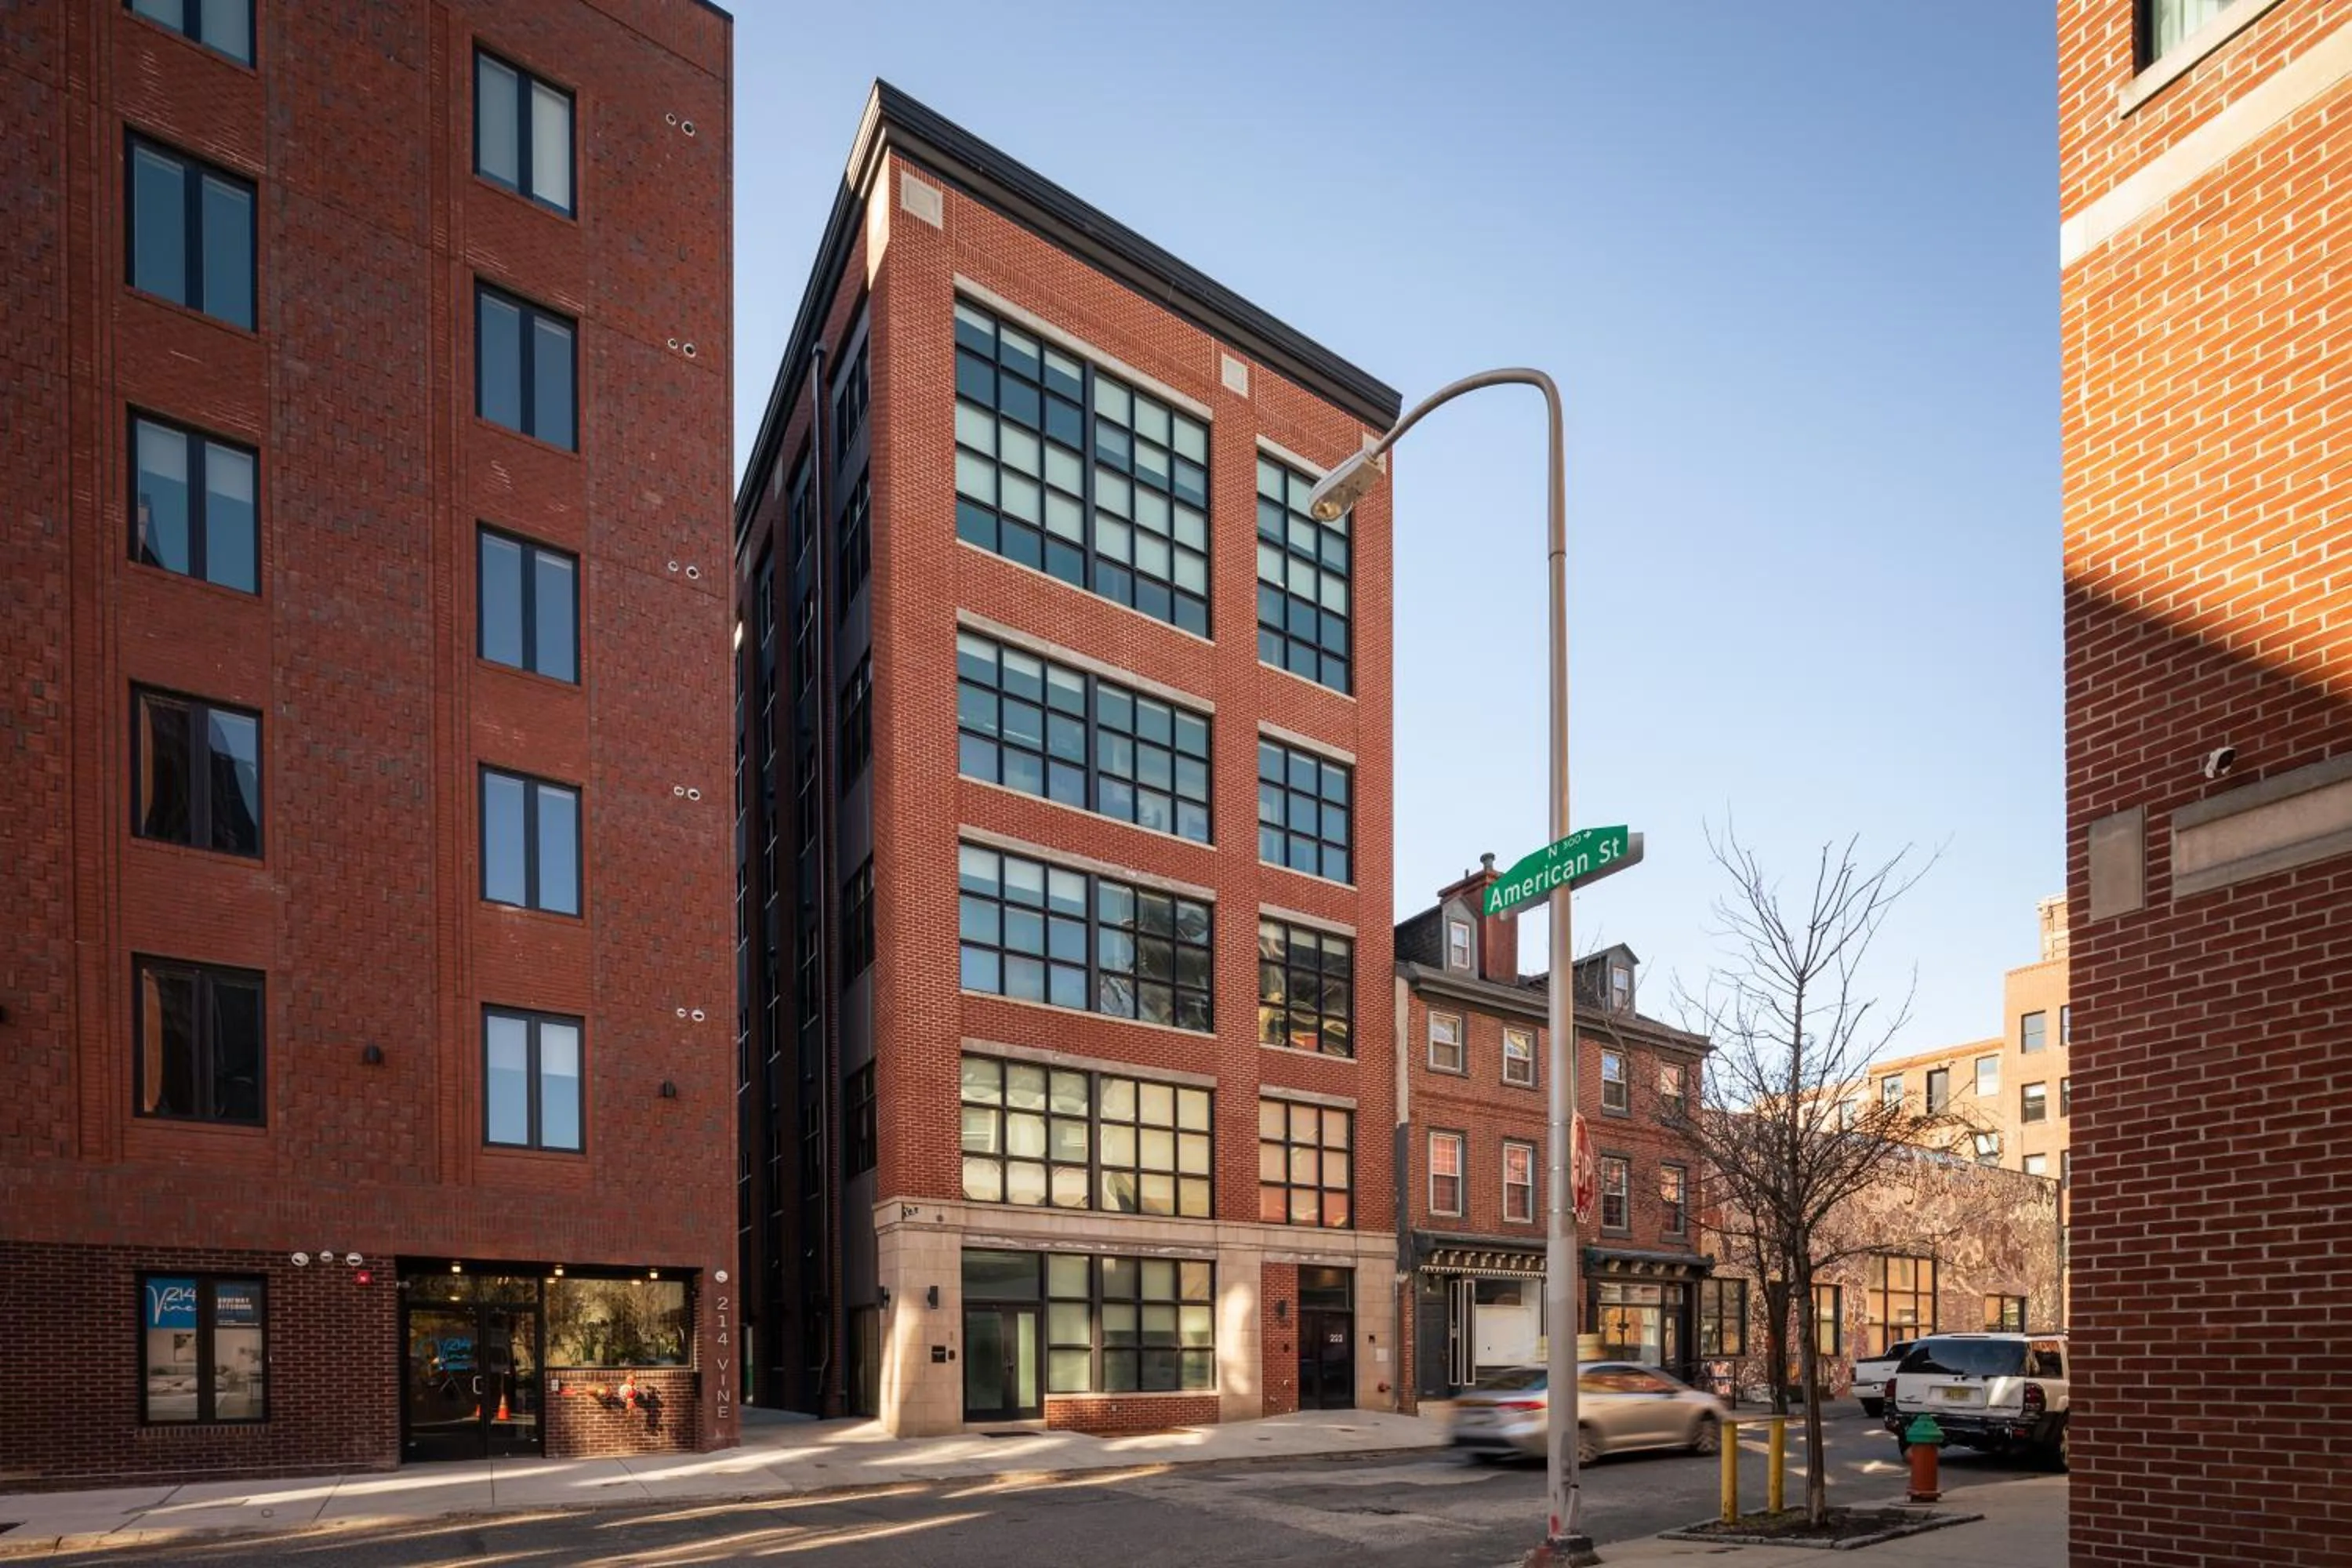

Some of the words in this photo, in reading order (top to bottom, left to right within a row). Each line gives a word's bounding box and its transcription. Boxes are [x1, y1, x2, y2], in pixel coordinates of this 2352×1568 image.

[1489, 852, 1588, 912] American
[1598, 837, 1621, 864] St
[1548, 844, 1558, 859] N
[166, 1287, 196, 1302] 214
[717, 1297, 729, 1346] 214
[717, 1359, 731, 1418] VINE
